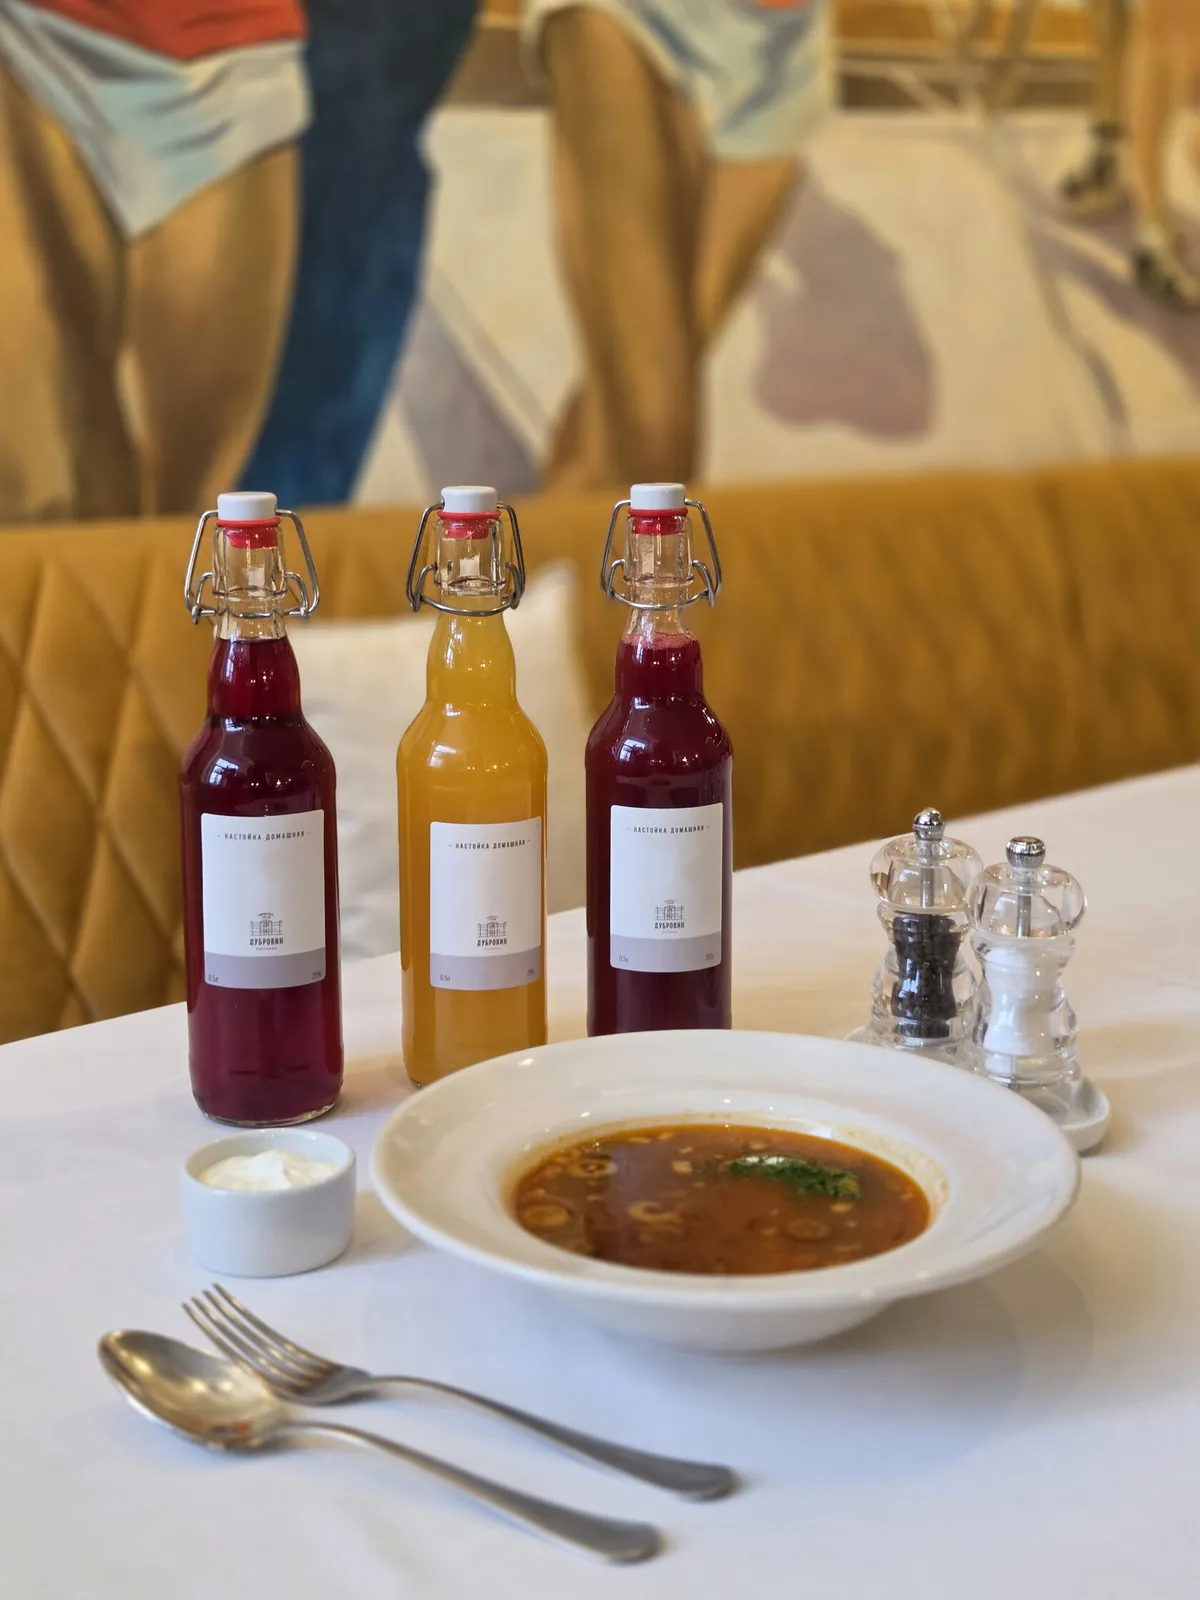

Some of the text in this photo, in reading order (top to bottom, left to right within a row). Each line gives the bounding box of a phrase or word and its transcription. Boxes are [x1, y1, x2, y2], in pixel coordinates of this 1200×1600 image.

[633, 825, 704, 834] НАСТОЙКА ДОМАШНЯЯ
[224, 830, 305, 841] НАСТОЙКА ДОМАШНЯЯ
[455, 839, 526, 850] НАСТОЙКА ДОМАШНЯЯ
[654, 922, 684, 930] ДУБРОВИН
[249, 938, 284, 946] ДУБРОВИН
[477, 938, 508, 947] ДУБРОВИН
